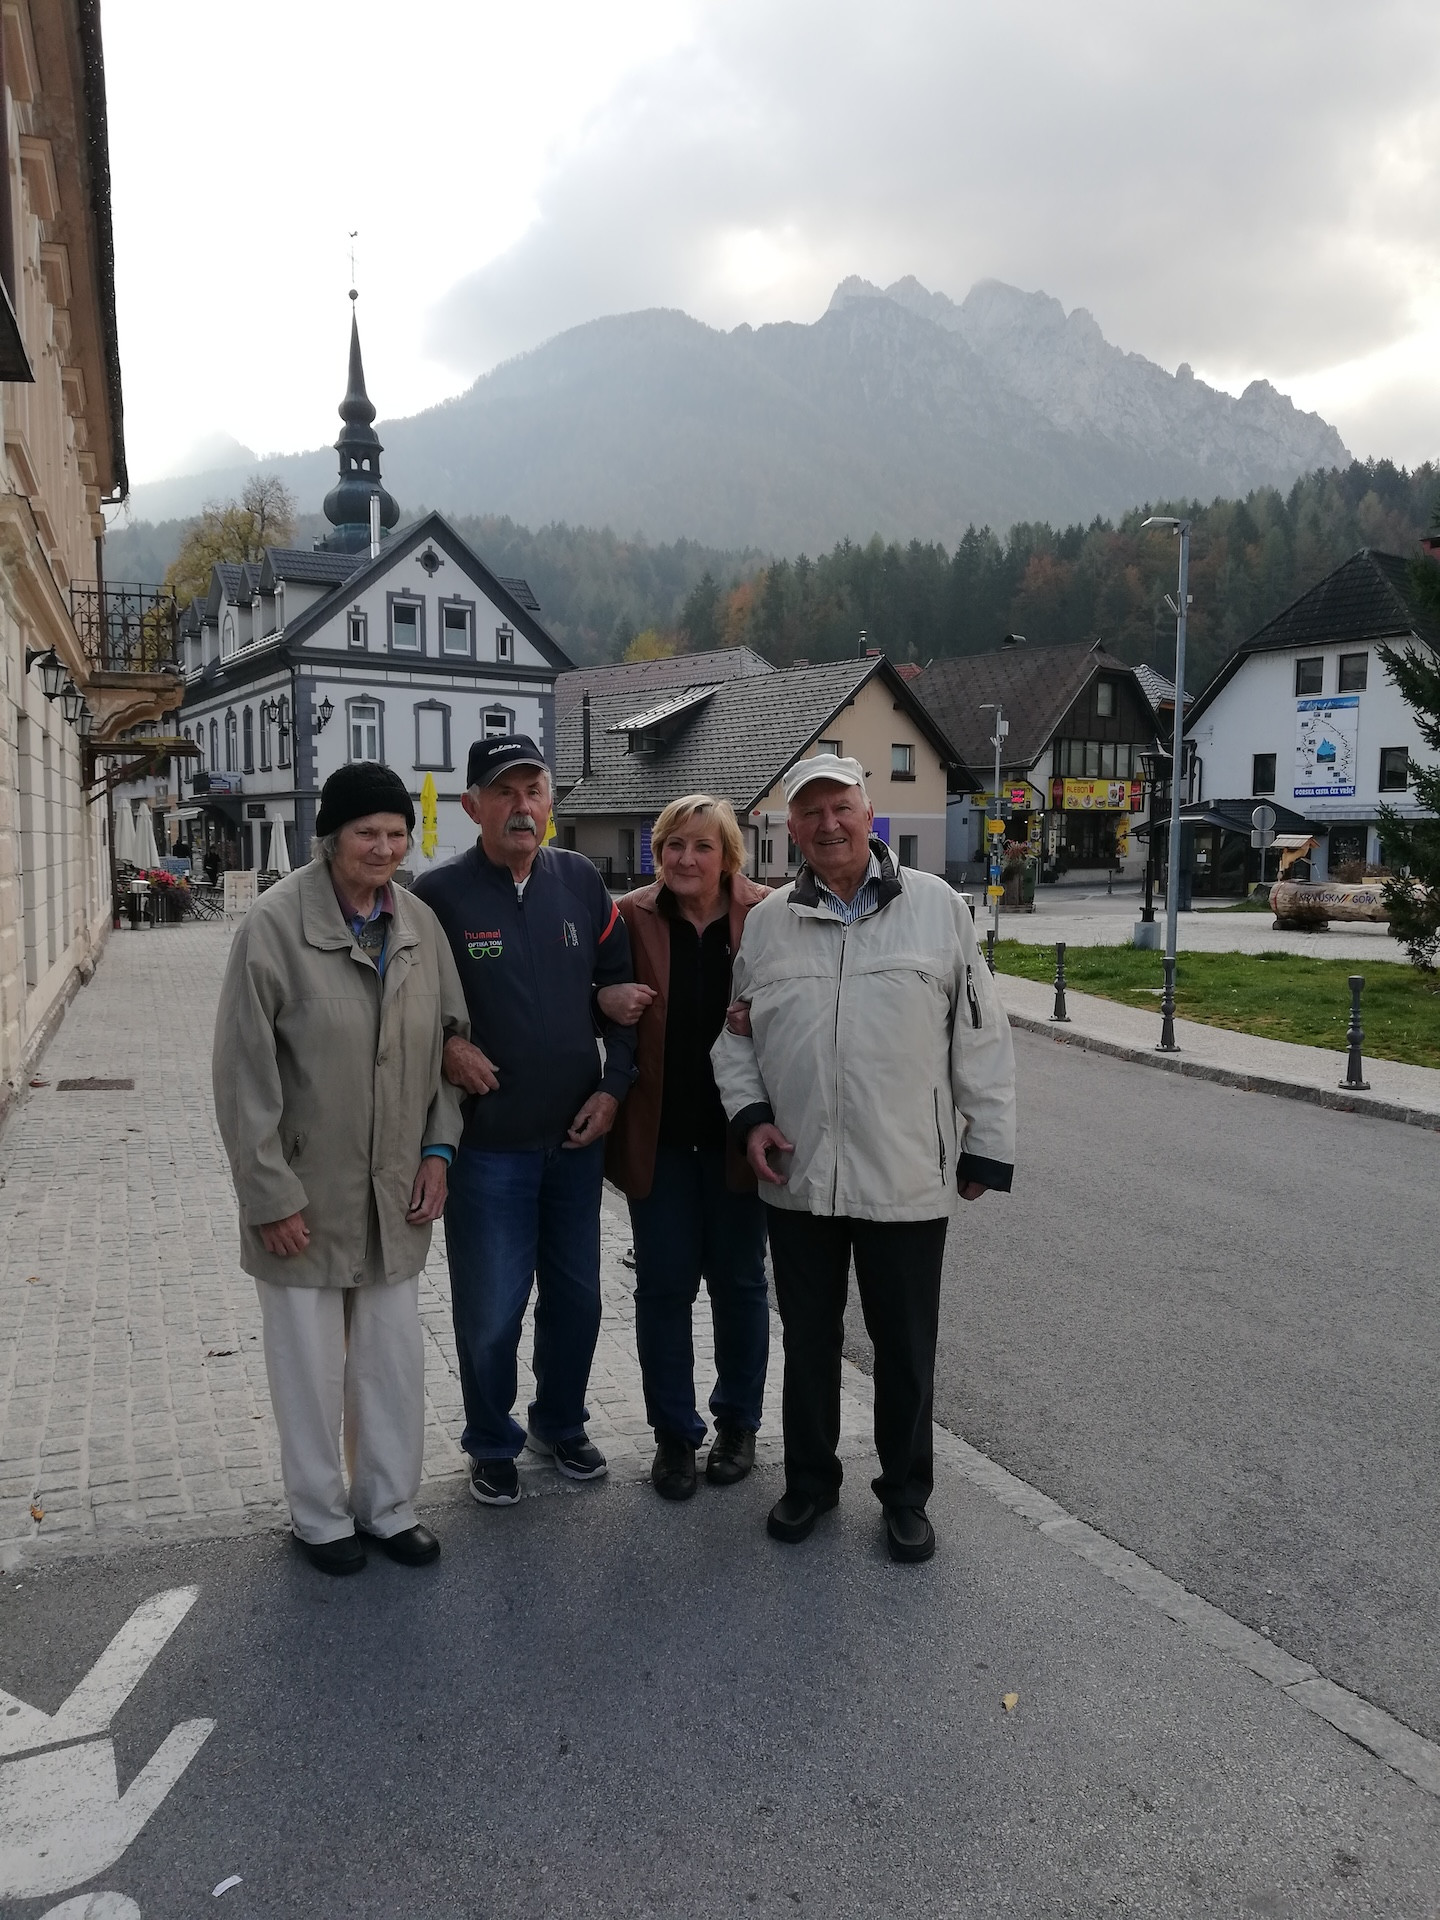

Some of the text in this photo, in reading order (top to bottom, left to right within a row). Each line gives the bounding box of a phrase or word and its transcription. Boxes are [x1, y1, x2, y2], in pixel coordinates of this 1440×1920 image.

[487, 743, 522, 756] elan
[1295, 788, 1315, 796] GORSKA
[1299, 892, 1378, 905] KRANJSKA GORA
[464, 928, 501, 940] hummel
